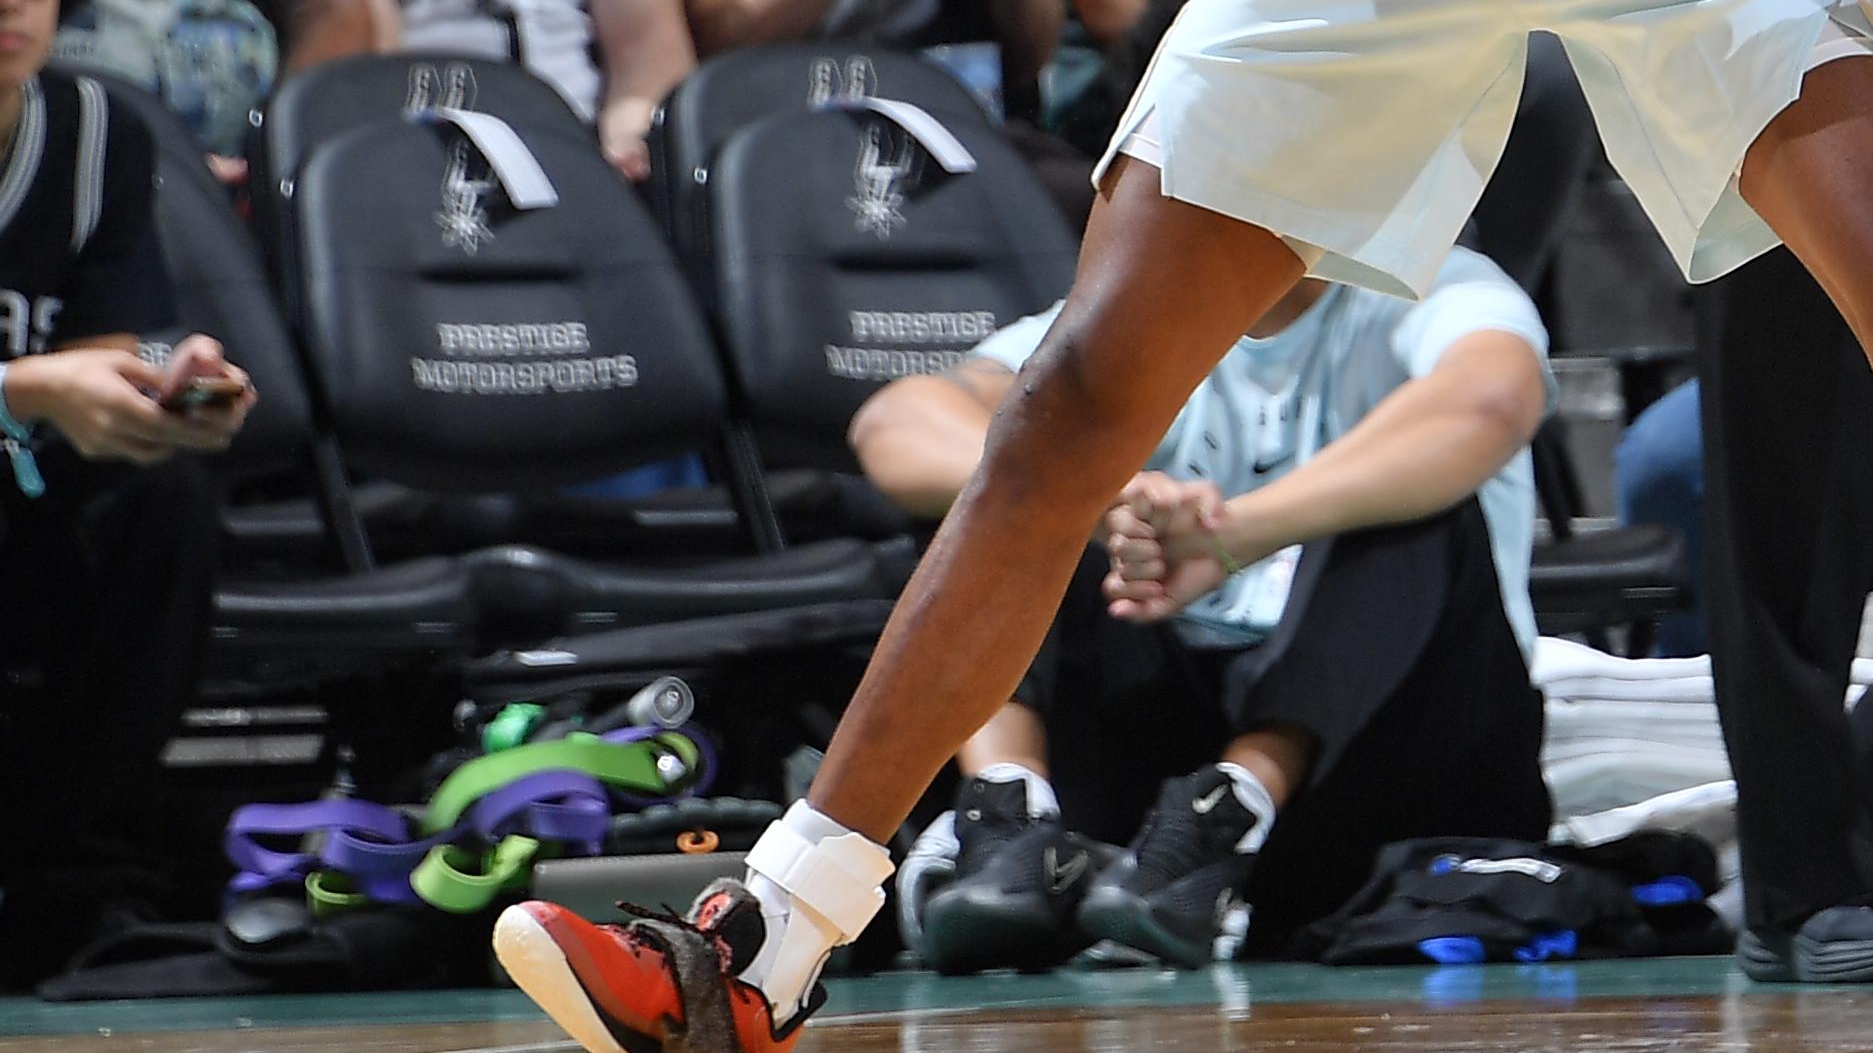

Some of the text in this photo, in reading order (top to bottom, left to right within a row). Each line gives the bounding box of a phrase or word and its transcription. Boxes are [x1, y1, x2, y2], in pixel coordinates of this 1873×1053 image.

[437, 321, 592, 357] PRESTIGE
[850, 310, 997, 344] PRESTIGE
[411, 354, 639, 395] MOTORSPORTS
